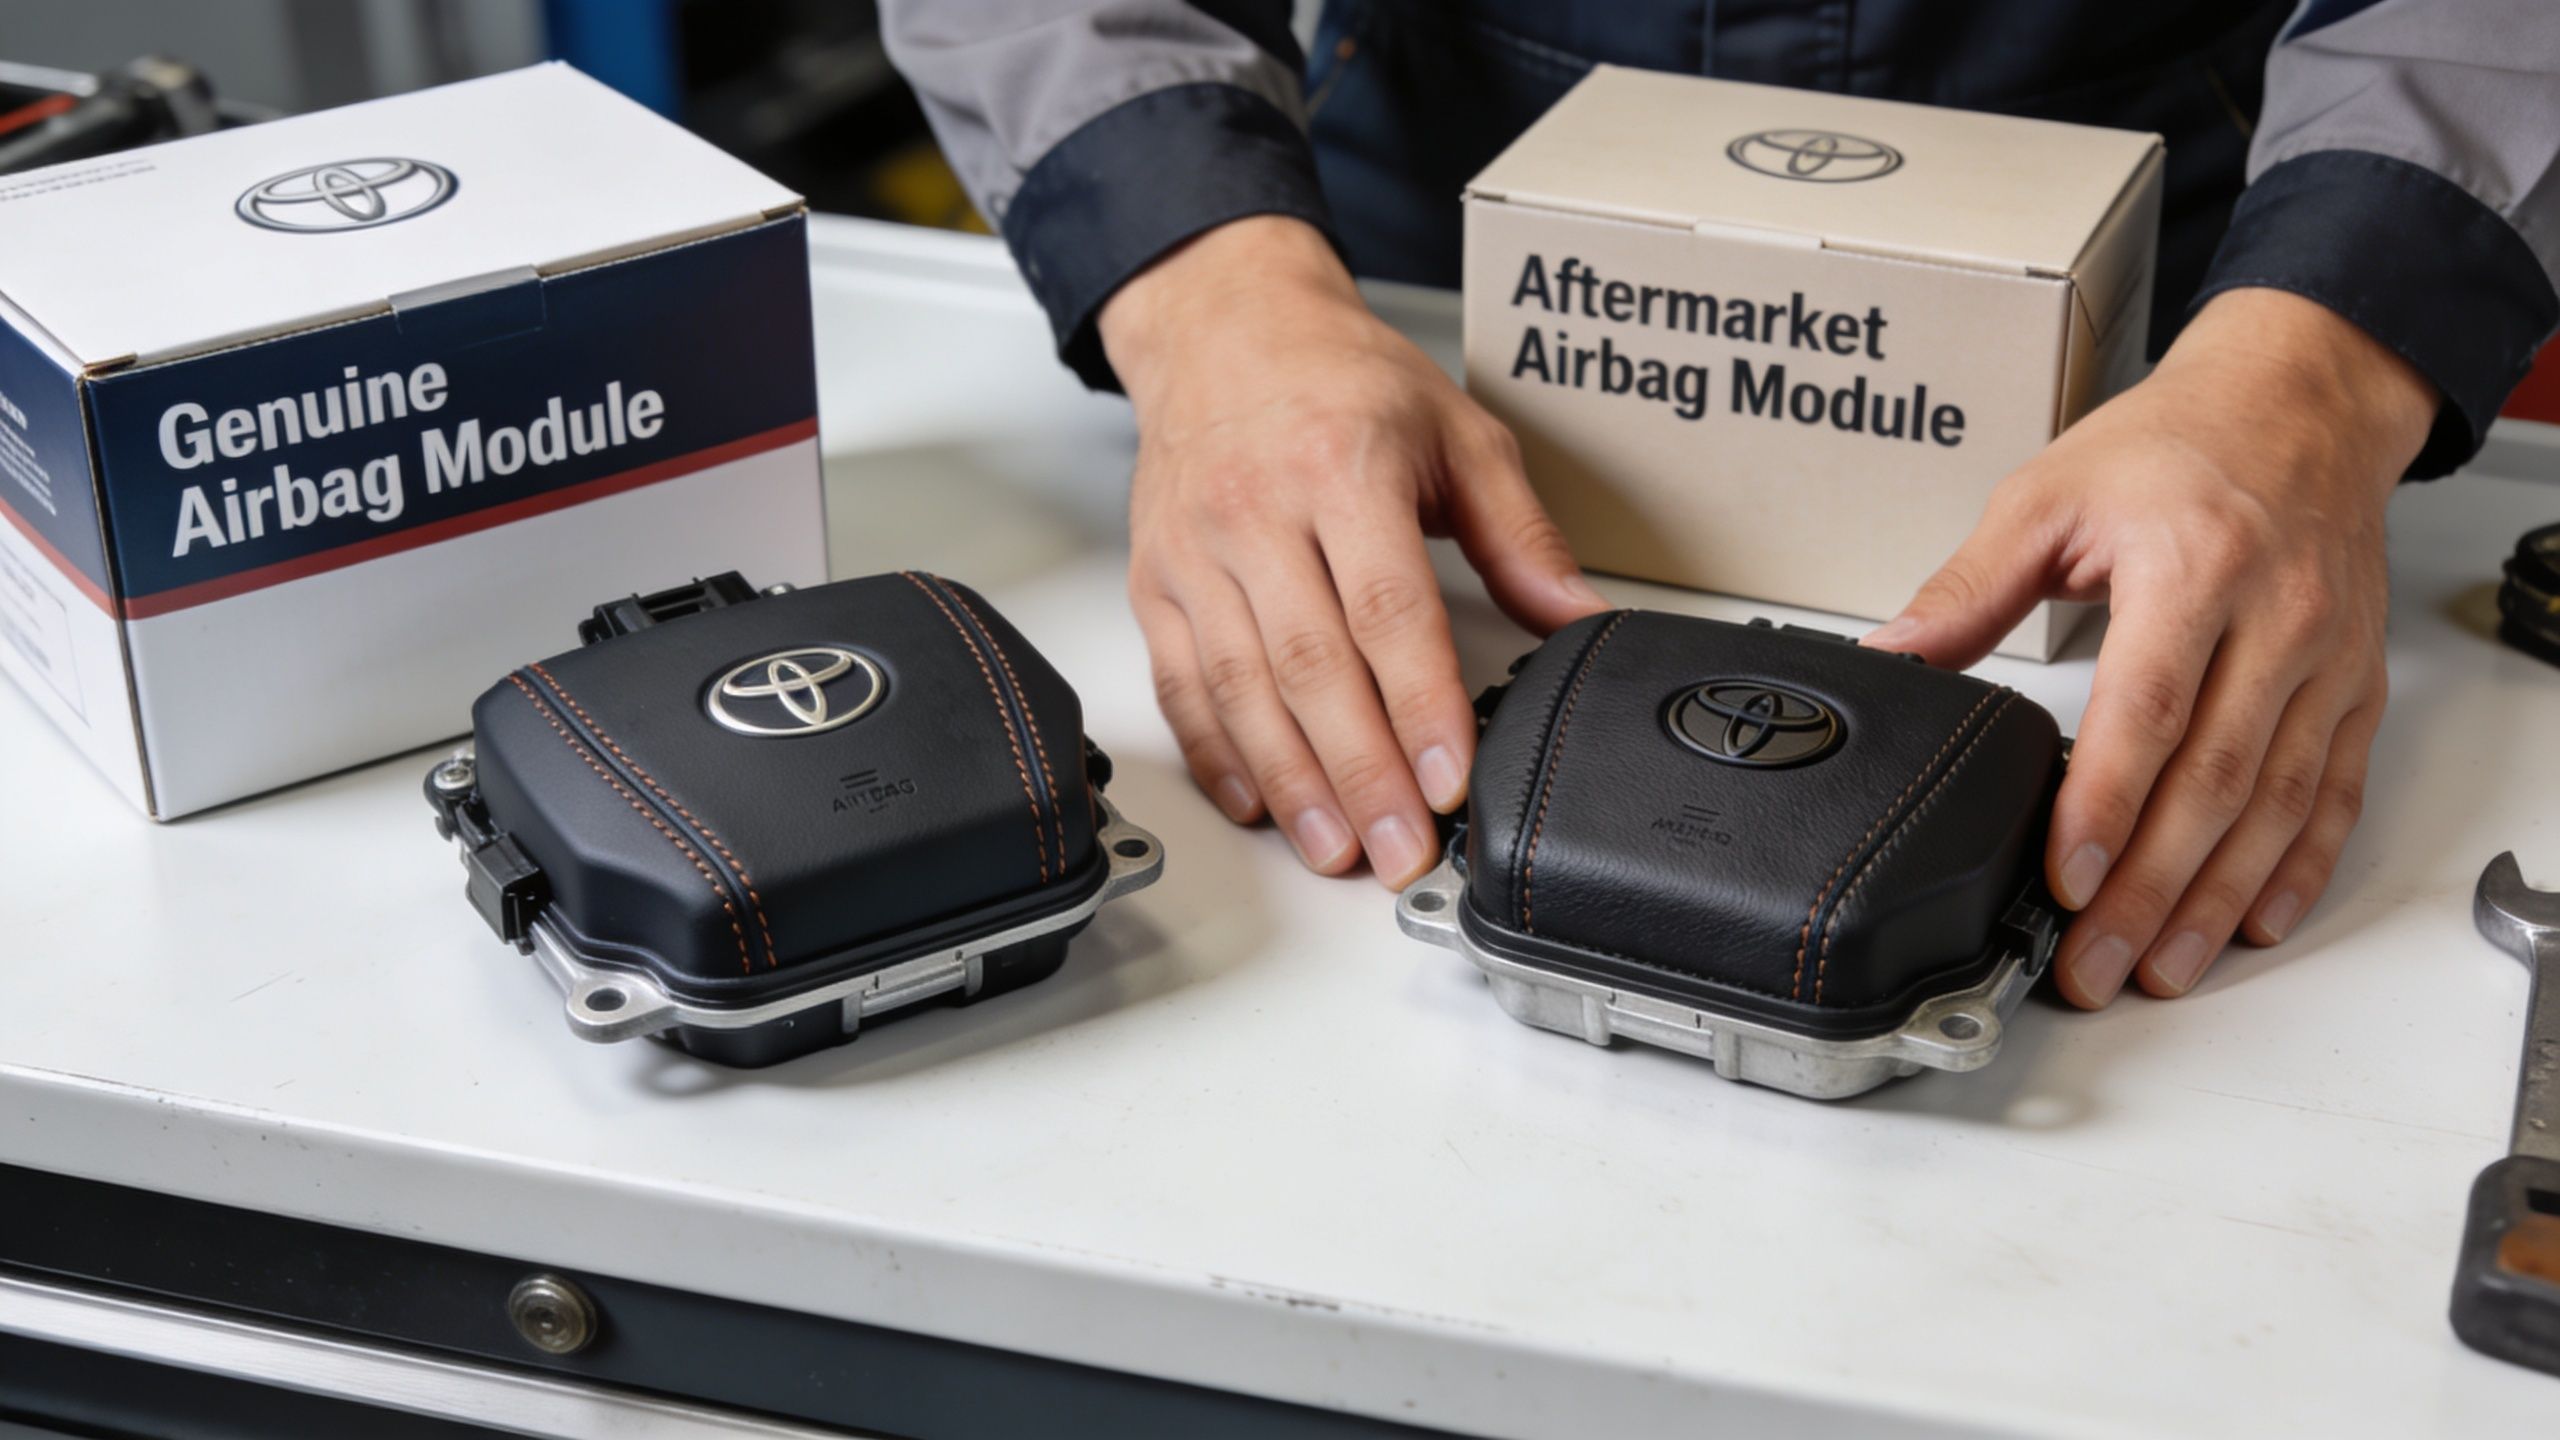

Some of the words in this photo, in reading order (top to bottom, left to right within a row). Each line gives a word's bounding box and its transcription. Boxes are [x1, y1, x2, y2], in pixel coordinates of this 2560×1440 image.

[1510, 254, 1888, 361] Aftermarket
[158, 362, 448, 470] Genuine
[1510, 326, 1709, 421] Airbag
[1731, 357, 1966, 447] Module
[172, 454, 404, 558] Airbag
[421, 380, 665, 494] Module
